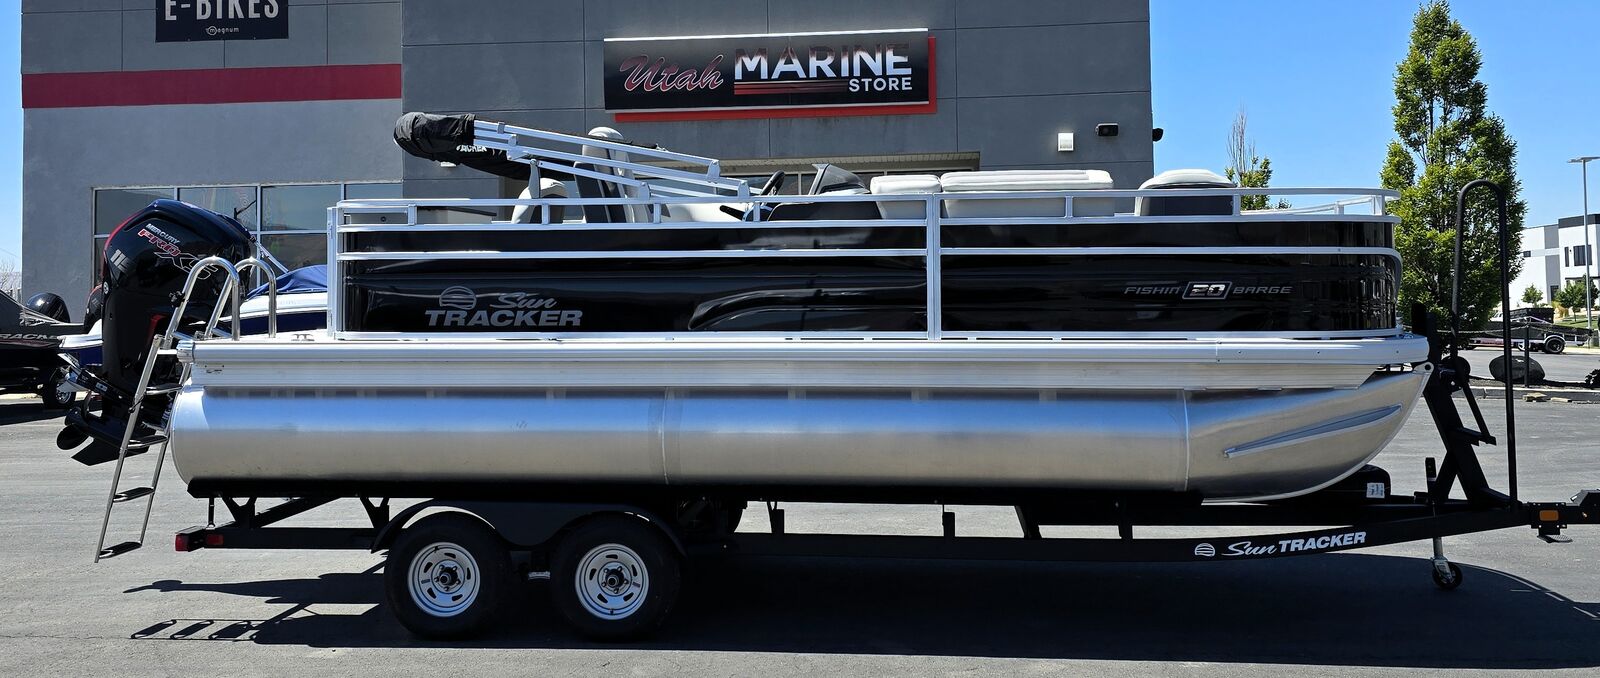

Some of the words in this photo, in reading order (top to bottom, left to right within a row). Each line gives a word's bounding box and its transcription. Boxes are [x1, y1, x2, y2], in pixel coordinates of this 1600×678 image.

[165, 0, 279, 20] E-BIKES
[733, 42, 912, 80] MARINE
[619, 53, 724, 92] Utah
[848, 77, 913, 92] STORE
[137, 228, 182, 257] PRO
[145, 223, 180, 244] MERCURY
[489, 292, 558, 309] Sun
[1189, 284, 1226, 297] 20
[1233, 286, 1294, 294] BARGE
[425, 310, 583, 327] TRACKER
[1221, 541, 1278, 556] Sun
[1278, 531, 1367, 553] TRACKER
